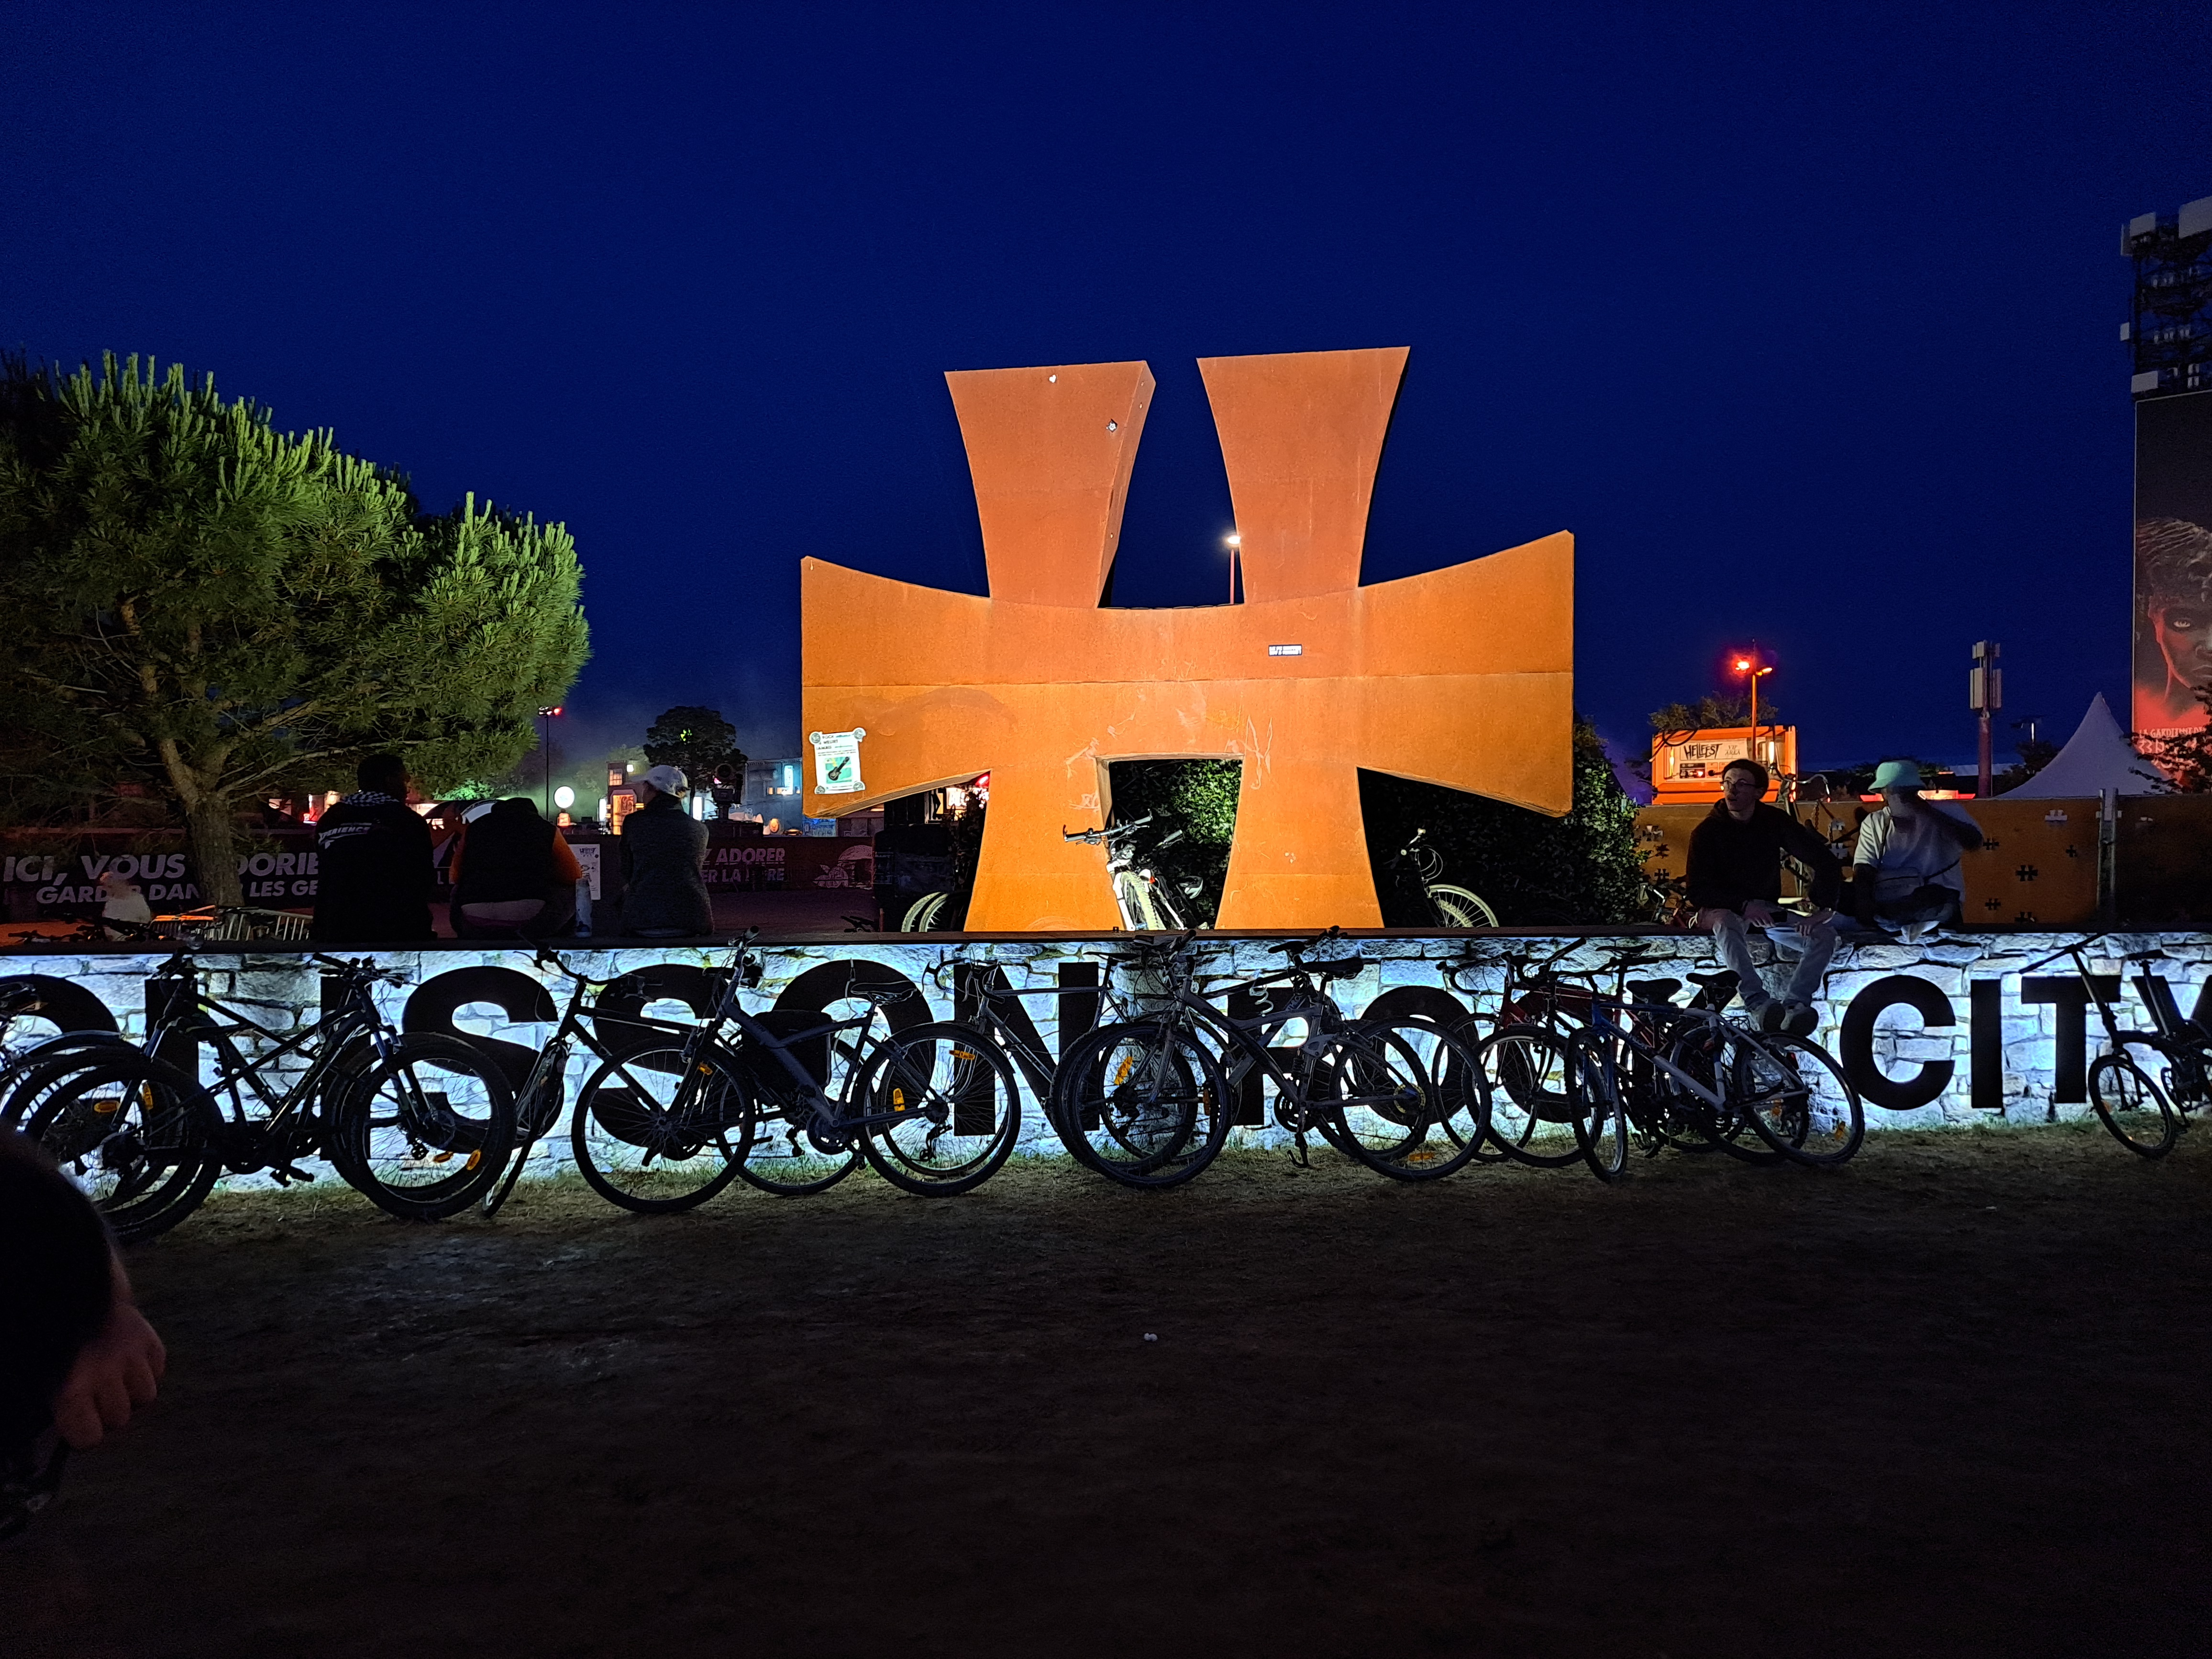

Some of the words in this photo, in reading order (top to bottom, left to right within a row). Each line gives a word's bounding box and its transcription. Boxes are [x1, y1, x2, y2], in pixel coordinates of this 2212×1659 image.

[1683, 742, 1723, 760] HELLFEST
[716, 848, 785, 864] ADORER
[3, 855, 68, 886] ICI,
[80, 853, 186, 880] VOUS
[249, 881, 285, 897] LES
[1227, 977, 1741, 1127] ROC
[1840, 974, 2212, 1111] CITY
